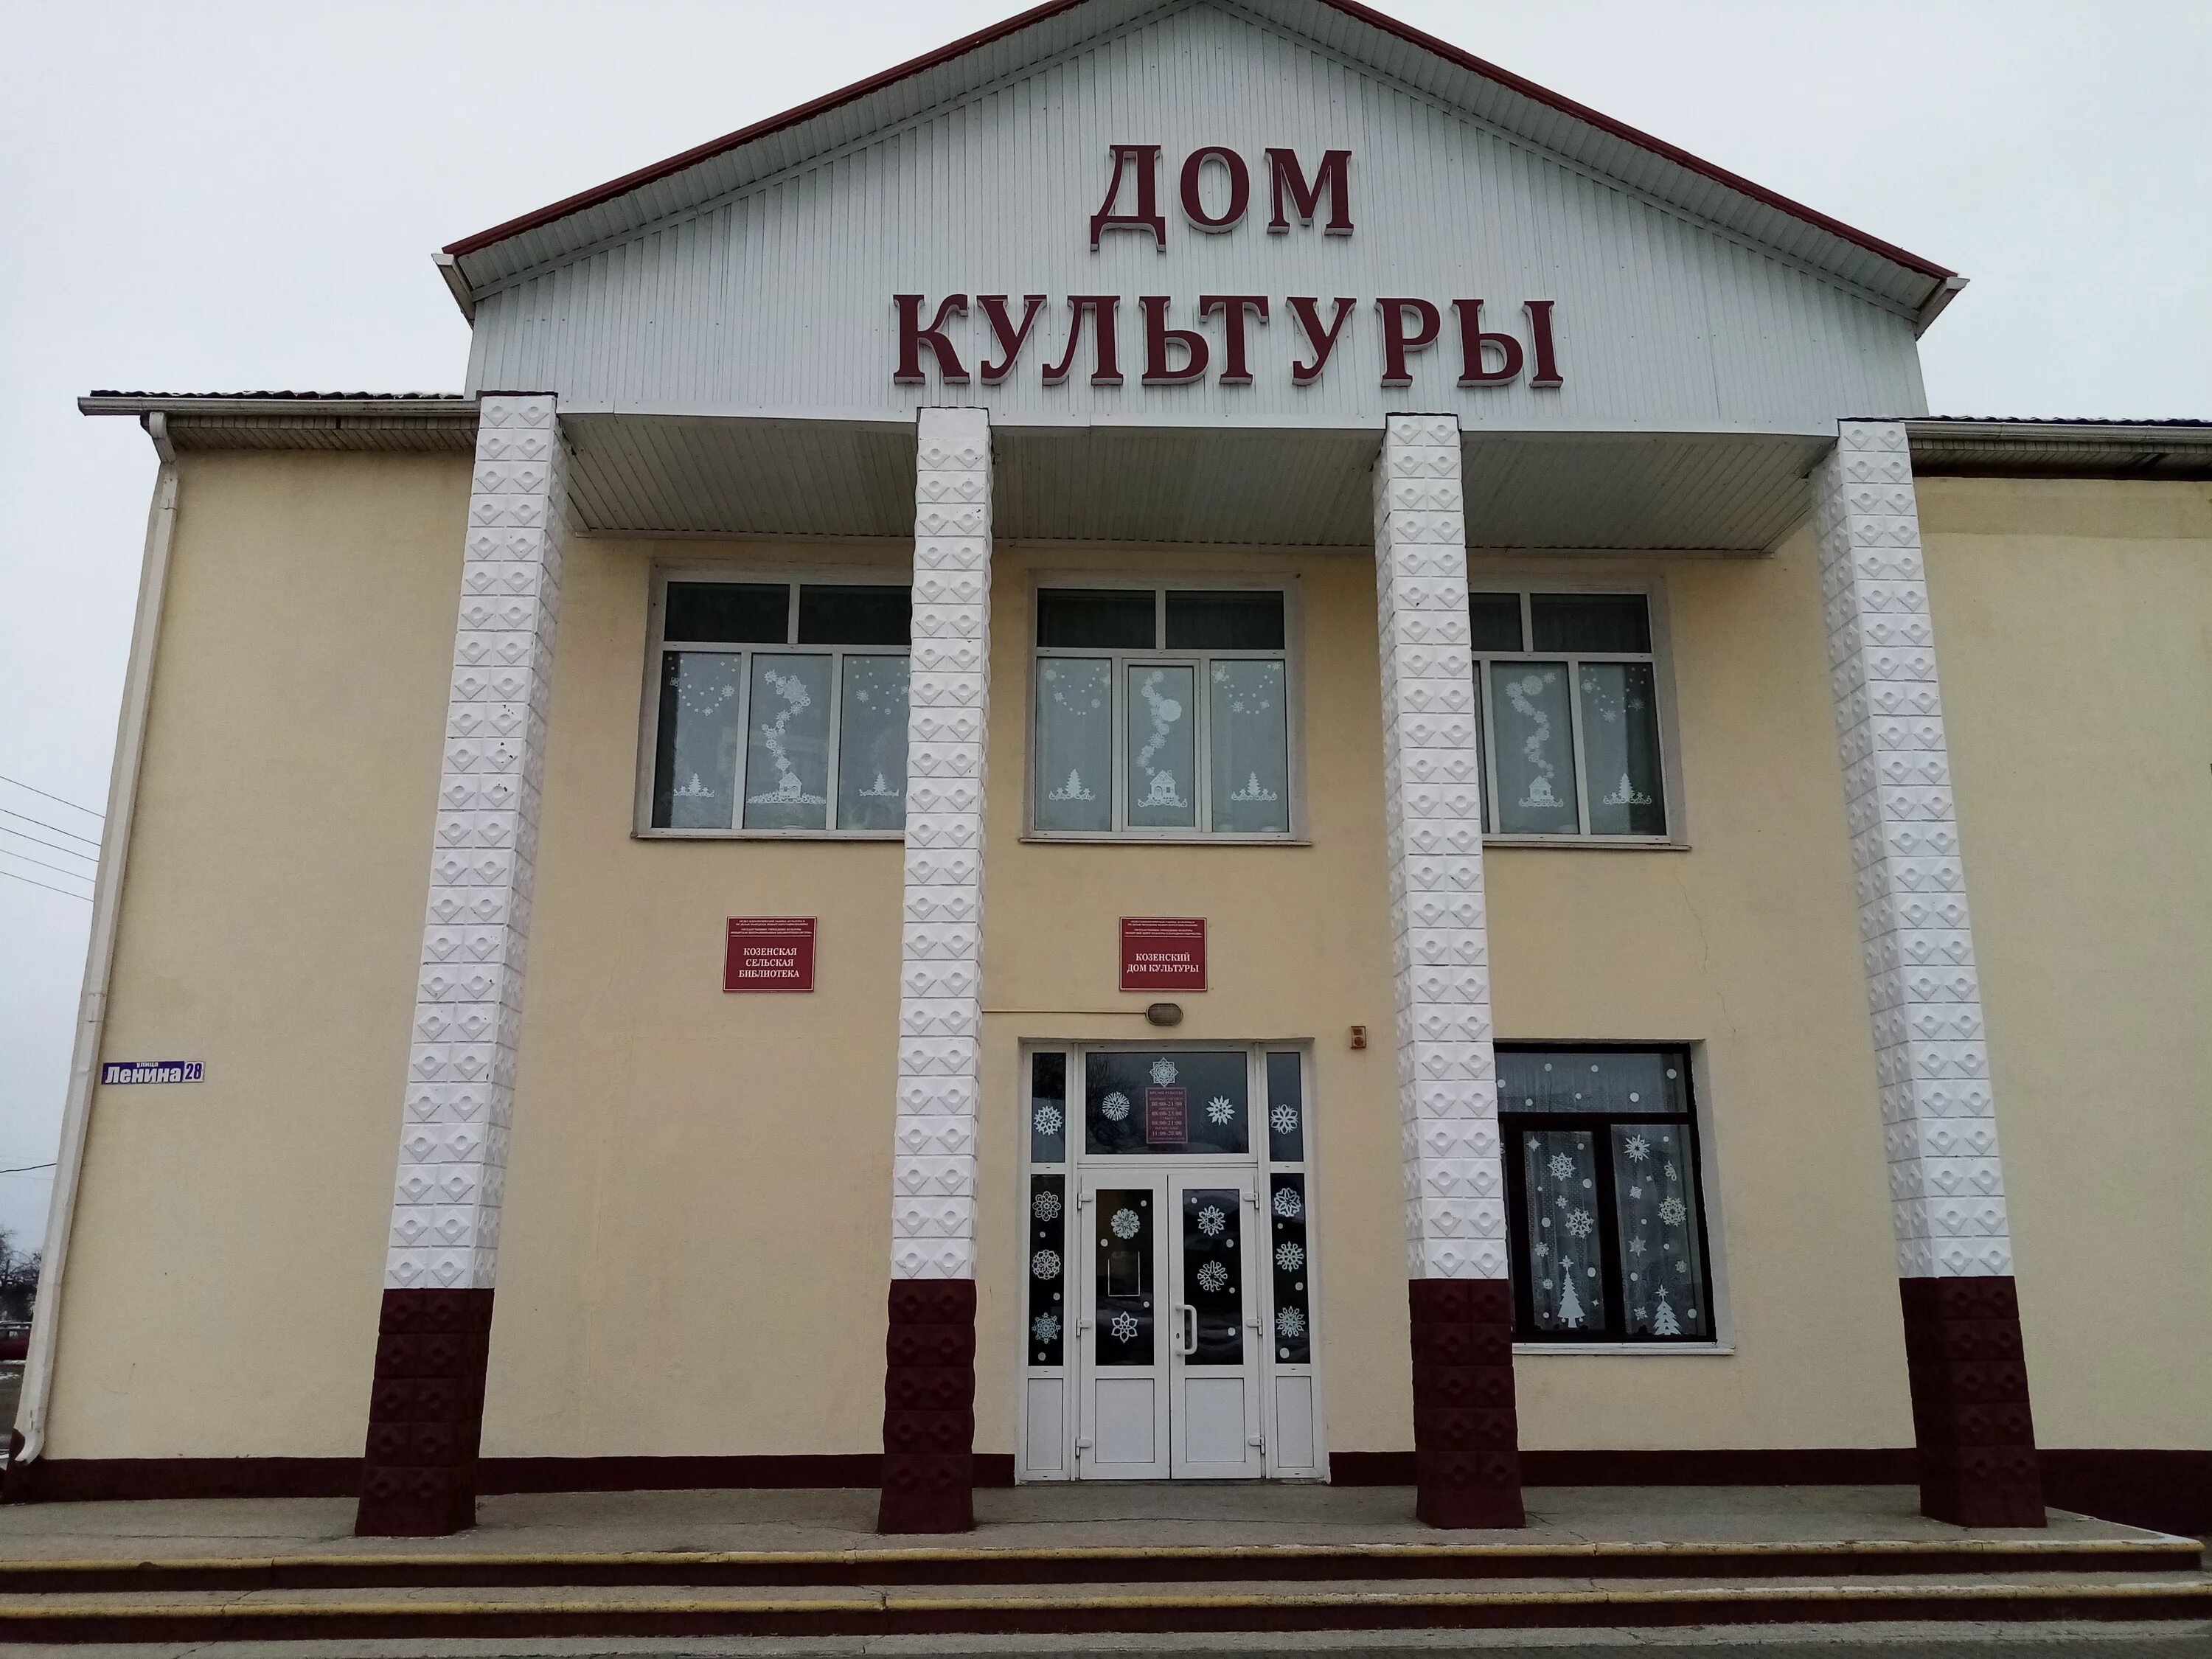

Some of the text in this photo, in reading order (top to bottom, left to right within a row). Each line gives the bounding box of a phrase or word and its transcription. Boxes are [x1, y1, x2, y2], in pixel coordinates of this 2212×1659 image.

[1090, 145, 1354, 252] ДОМ
[892, 293, 1564, 388] КУЛЬТУРЫ
[743, 947, 797, 956] КОЗЕНСКАЯ
[1135, 952, 1191, 961] КОЗЕНСКИЙ
[745, 959, 794, 967] СЕЛЬСКАЯ
[1127, 964, 1199, 973] ДОМ КУЛЬТУРЫ
[738, 970, 800, 978] БИБЛИОТЕКА
[105, 1062, 203, 1083] Ленина 28
